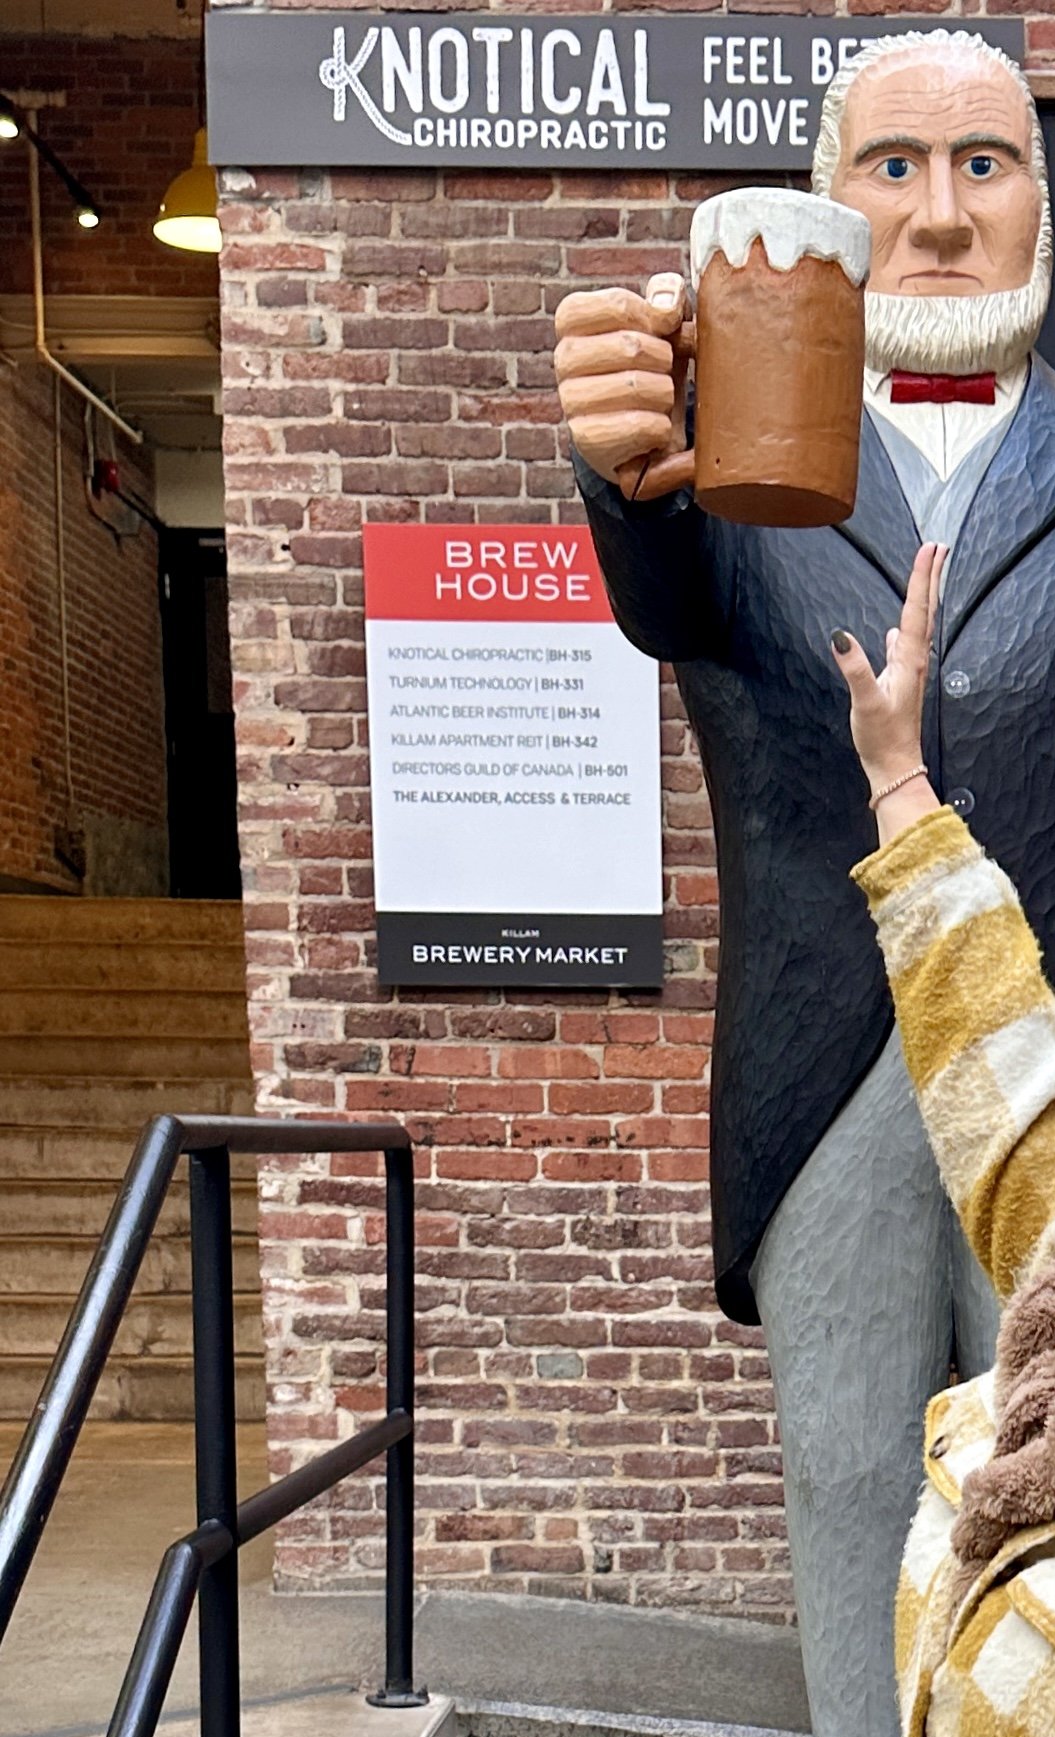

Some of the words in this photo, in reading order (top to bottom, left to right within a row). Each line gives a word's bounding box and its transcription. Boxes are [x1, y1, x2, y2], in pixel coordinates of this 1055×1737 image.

[703, 36, 793, 85] FEEL
[319, 26, 671, 146] KNOTICAL
[703, 97, 809, 146] MOVE
[413, 117, 666, 151] CHIROPRACTIC
[445, 540, 578, 569] BREW
[435, 572, 591, 602] HOUSE
[387, 646, 450, 661] KNOTICAL
[451, 647, 544, 663] CHIROPRACTIC
[388, 675, 448, 690] TURNIUM
[449, 676, 533, 691] TECHNOLOGY
[540, 677, 584, 691] BH-331
[389, 704, 450, 719] ATLANTIC
[451, 705, 485, 719] BEER
[486, 705, 550, 720] INSTITUTE
[557, 706, 601, 720] BH-314
[390, 733, 437, 747] KILLAM
[438, 733, 515, 748] APARTMENT
[516, 734, 544, 749] REIT
[551, 735, 598, 749] BH-342
[391, 761, 463, 776] DIRECTORS
[463, 762, 501, 777] GUILD
[502, 762, 520, 777] OF
[521, 763, 575, 777] CANADA
[584, 764, 628, 778] BH-501
[392, 790, 418, 803] THE
[420, 790, 502, 806] ALEXANDER,
[503, 791, 556, 805] ACCESS
[560, 792, 571, 805] &
[572, 792, 631, 806] TERRACE
[501, 929, 540, 939] KILLAM
[412, 944, 532, 964] BREWERY
[535, 947, 628, 965] MARKET
